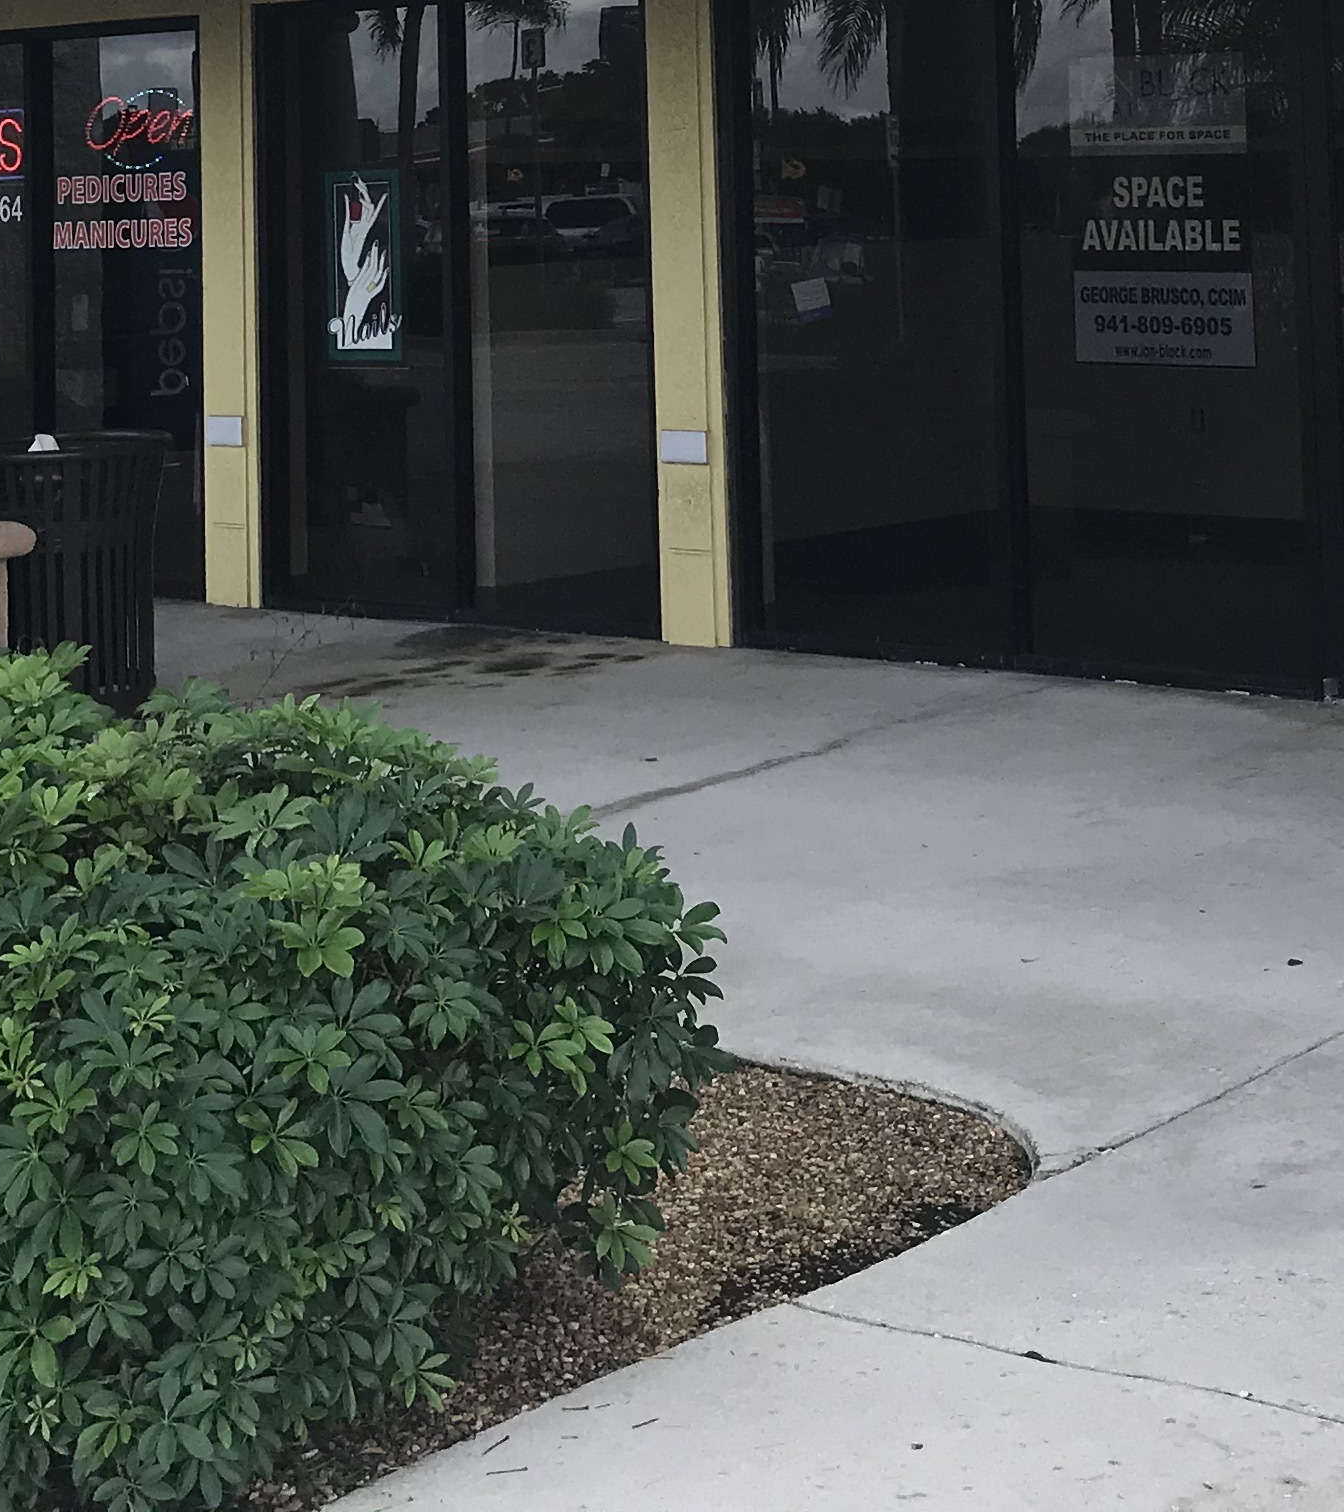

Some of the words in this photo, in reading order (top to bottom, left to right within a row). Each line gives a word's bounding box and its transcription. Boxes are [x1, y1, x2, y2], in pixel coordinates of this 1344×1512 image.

[84, 95, 194, 157] Open
[1085, 132, 1110, 143] THE
[1113, 131, 1155, 142] PLACE
[1159, 130, 1185, 141] FOR
[1189, 128, 1231, 140] SPACE
[57, 171, 188, 205] PEDICURES
[1113, 175, 1204, 208] SPACE
[53, 217, 193, 250] MANICURES
[1082, 219, 1241, 251] AVAILABLE
[1080, 286, 1138, 304] GEORGE
[1141, 287, 1204, 308] BRUSCO,
[1208, 288, 1247, 306] CCIM
[327, 301, 403, 347] Nails
[1094, 314, 1233, 336] 941-809-6905
